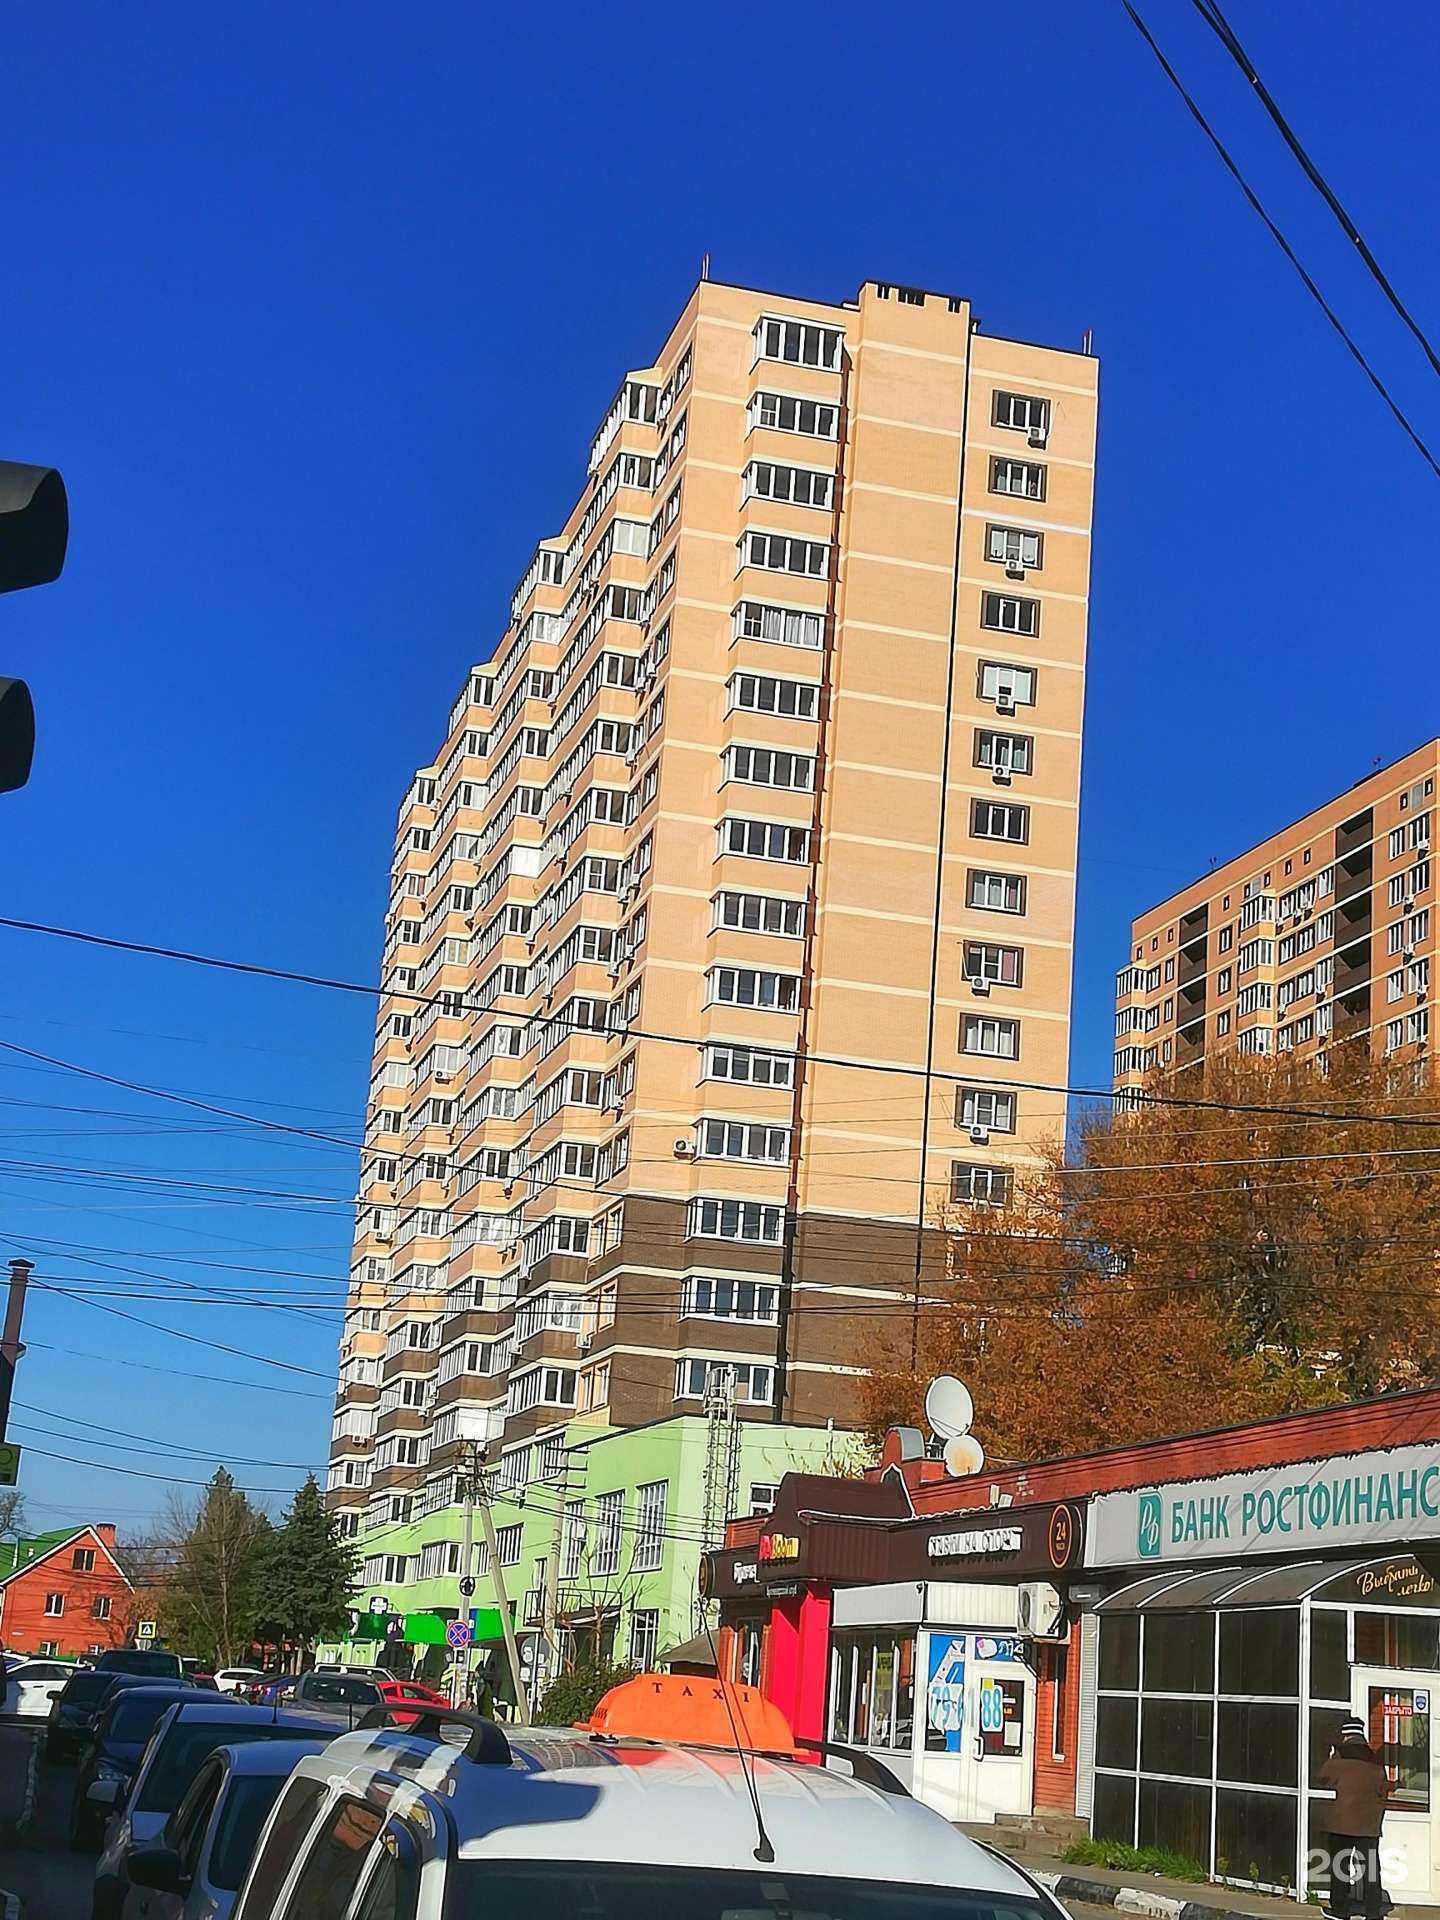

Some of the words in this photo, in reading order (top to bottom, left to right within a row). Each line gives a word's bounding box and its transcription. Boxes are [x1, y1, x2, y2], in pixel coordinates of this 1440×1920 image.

[1171, 1495, 1230, 1543] БАНК
[1241, 1466, 1440, 1536] РОСТФИНАНС
[1056, 1521, 1067, 1541] 24
[652, 1681, 750, 1703] TAXI
